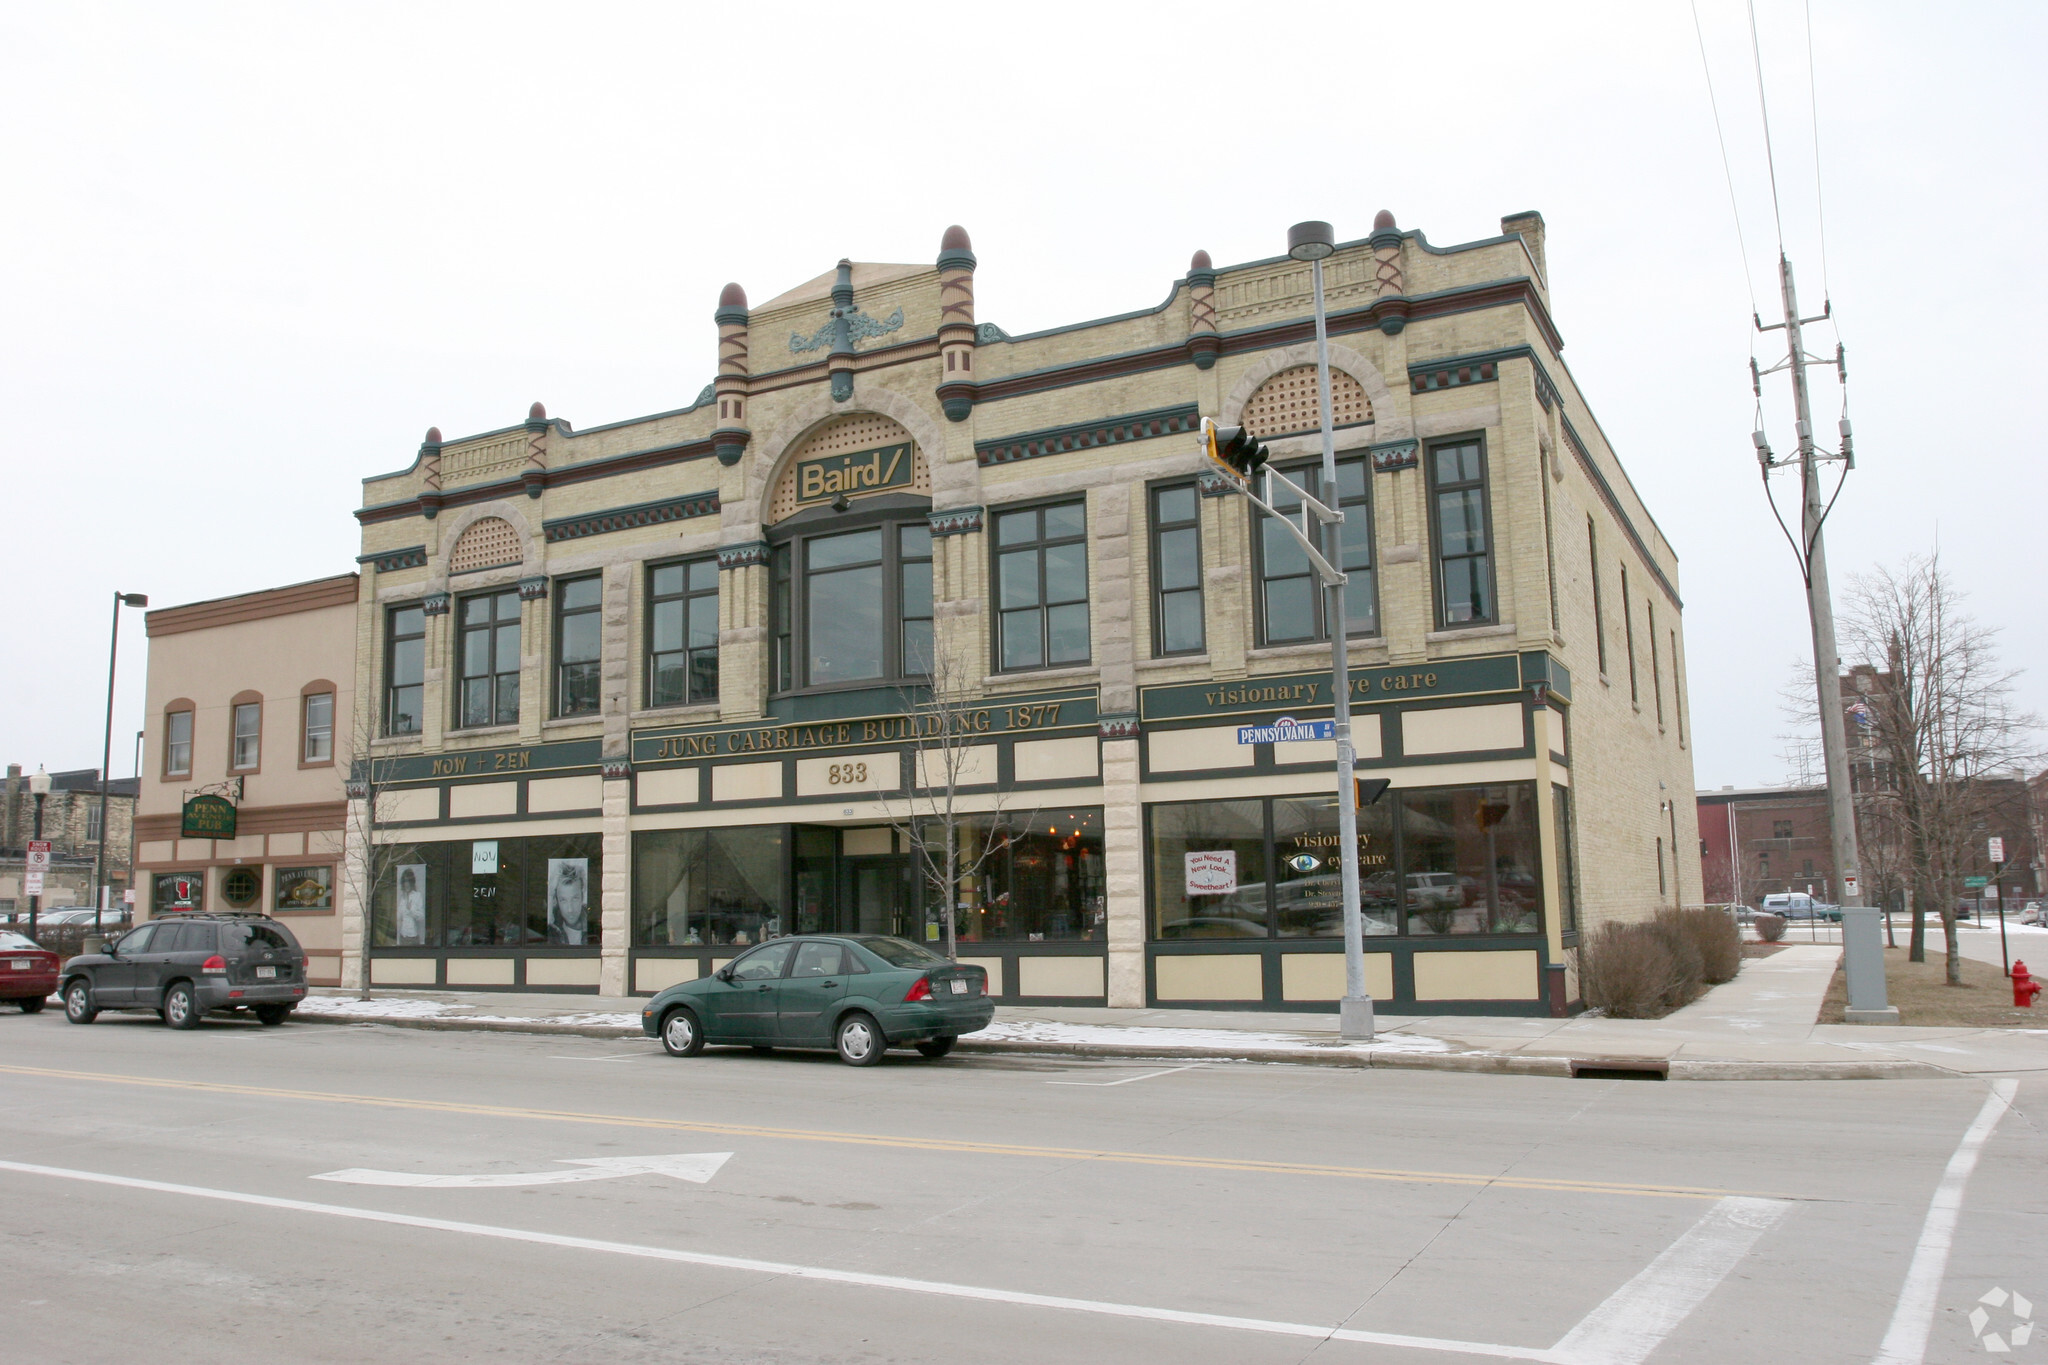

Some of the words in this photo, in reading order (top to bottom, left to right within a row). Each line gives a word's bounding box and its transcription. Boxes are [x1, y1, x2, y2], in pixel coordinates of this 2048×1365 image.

[1205, 684, 1319, 706] visionary
[1331, 678, 1370, 700] ye
[1381, 672, 1437, 691] care
[658, 735, 717, 758] JUNG
[727, 724, 851, 752] CARRIAGE
[1005, 704, 1061, 729] 1877
[1241, 725, 1316, 744] PENNSYLVANIA
[432, 756, 467, 775] NOW
[495, 751, 531, 770] ZEN
[828, 762, 868, 785] 833
[194, 804, 226, 813] PENN
[197, 819, 222, 830] PUB
[1294, 831, 1371, 849] visionry
[474, 851, 497, 862] NOW
[1203, 854, 1222, 863] Need
[1359, 854, 1386, 865] are
[1191, 865, 1206, 874] New
[1190, 879, 1232, 891] Sweetheart!
[473, 887, 497, 898] ZEN
